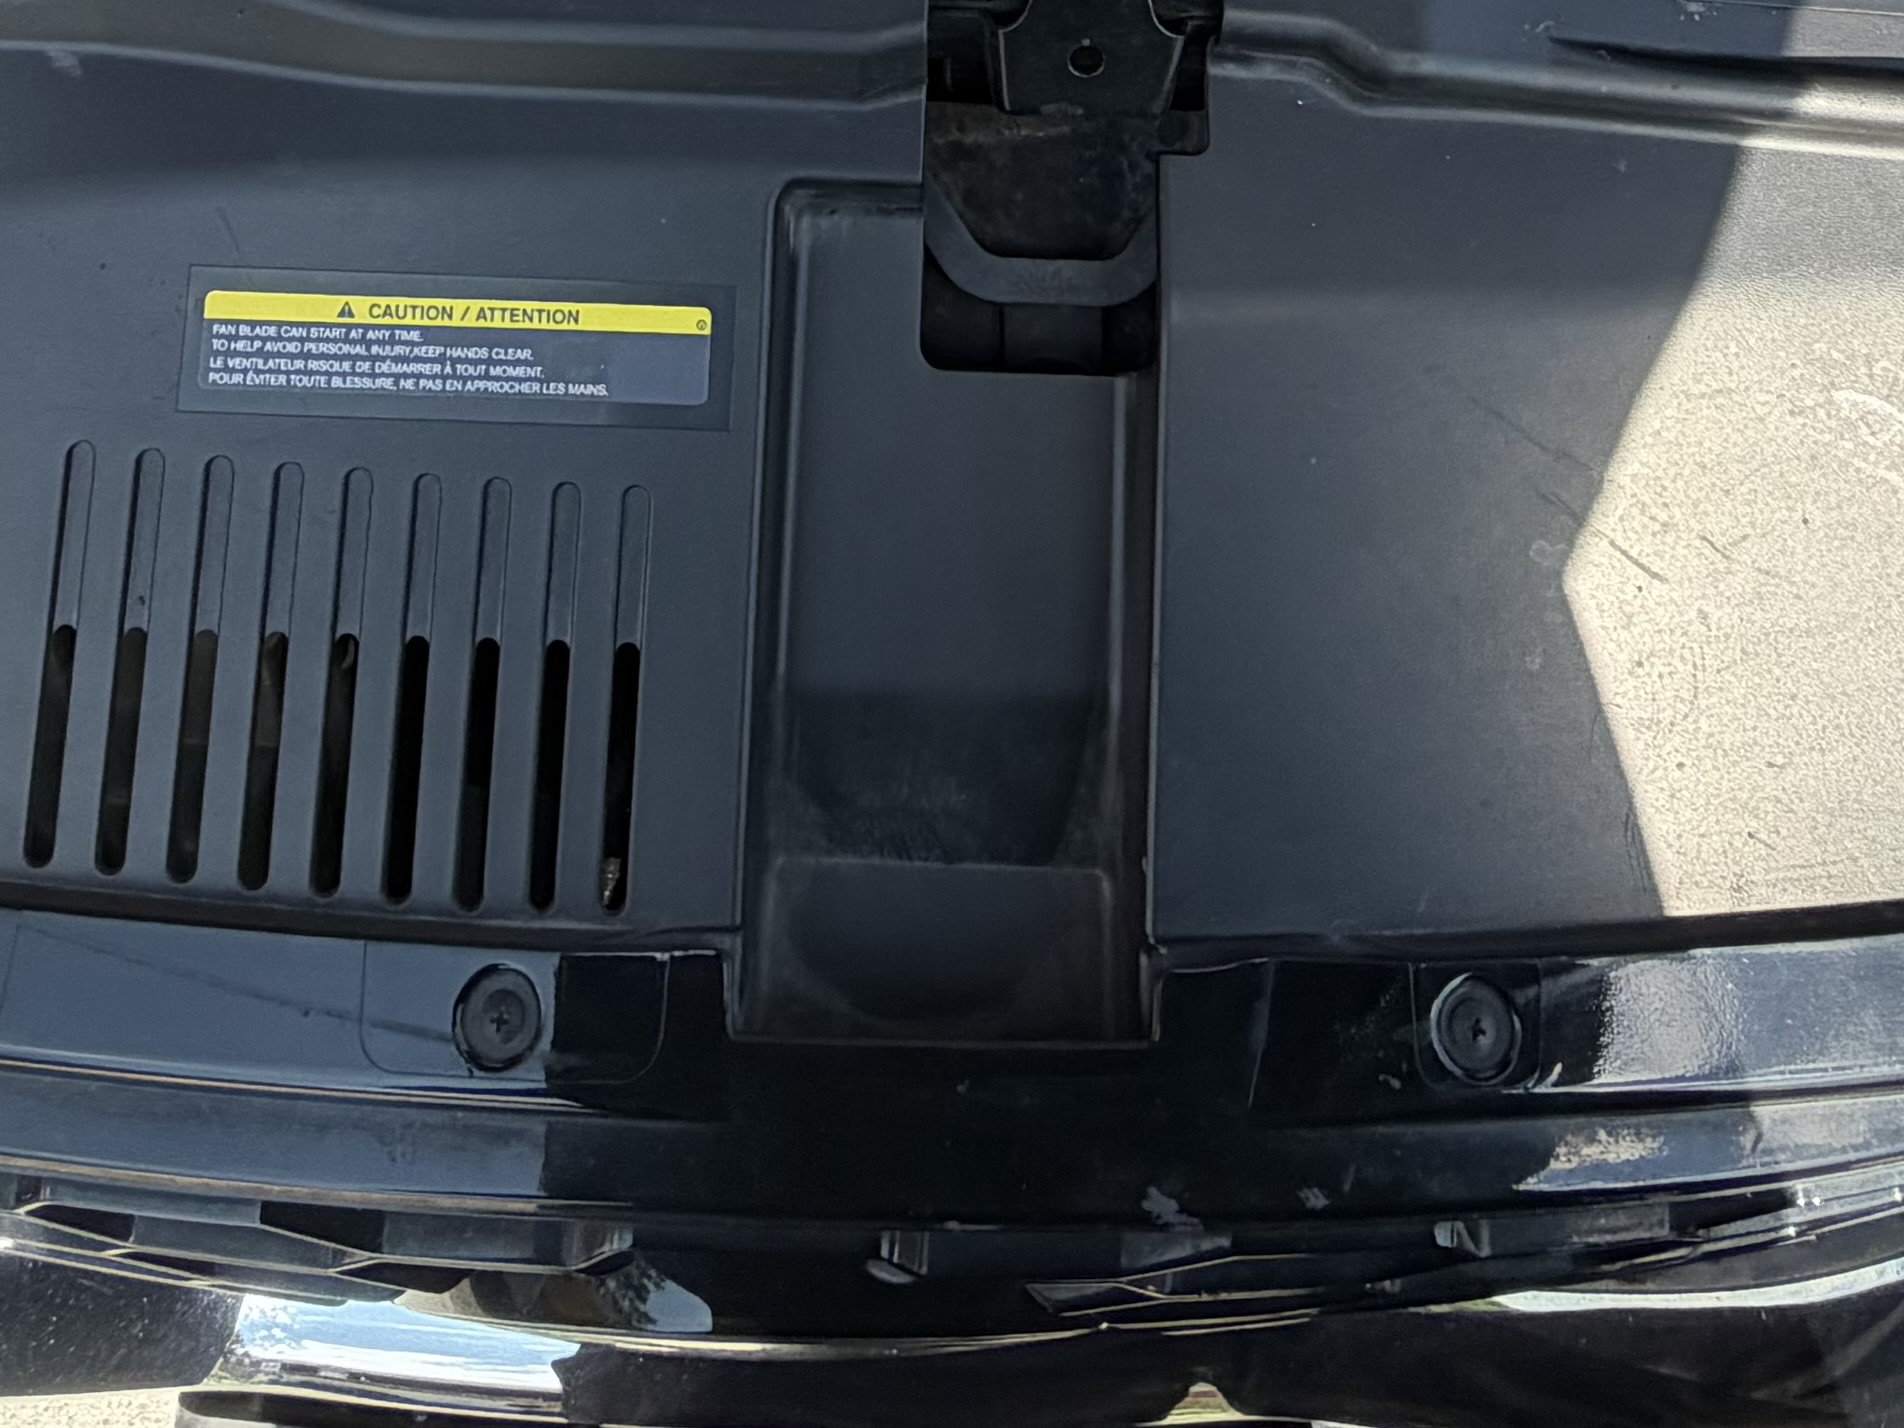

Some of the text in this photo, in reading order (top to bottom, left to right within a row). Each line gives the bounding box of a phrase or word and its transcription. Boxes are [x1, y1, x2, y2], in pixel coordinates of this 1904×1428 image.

[368, 303, 580, 325] CAUTION / ATTENTION
[212, 324, 236, 336] FAN
[238, 325, 278, 337] BLADE
[281, 326, 307, 338] CAN
[310, 327, 346, 339] START
[349, 328, 363, 339] AT
[366, 329, 390, 340] ANY
[212, 339, 228, 351] TO
[231, 340, 262, 352] HELP
[264, 342, 301, 353] AVOID
[304, 343, 368, 355] PERSONAL
[447, 347, 489, 360] HANDS
[209, 357, 224, 368] LE
[228, 357, 305, 371] VENTILATEUR
[308, 360, 353, 373] RISQUE
[355, 362, 372, 373] DE
[375, 359, 441, 375] DÉMARRER
[444, 360, 452, 375] À
[456, 364, 486, 376] TOUT
[208, 373, 244, 385] POUR
[246, 371, 287, 386] ÉVITER
[290, 376, 328, 387] TOUTE
[330, 377, 397, 390] BLESSURE,
[400, 379, 416, 390] NE
[419, 380, 443, 390] PAS
[445, 380, 462, 391] EN
[464, 380, 540, 395] APPROCHER
[543, 384, 566, 395] LES
